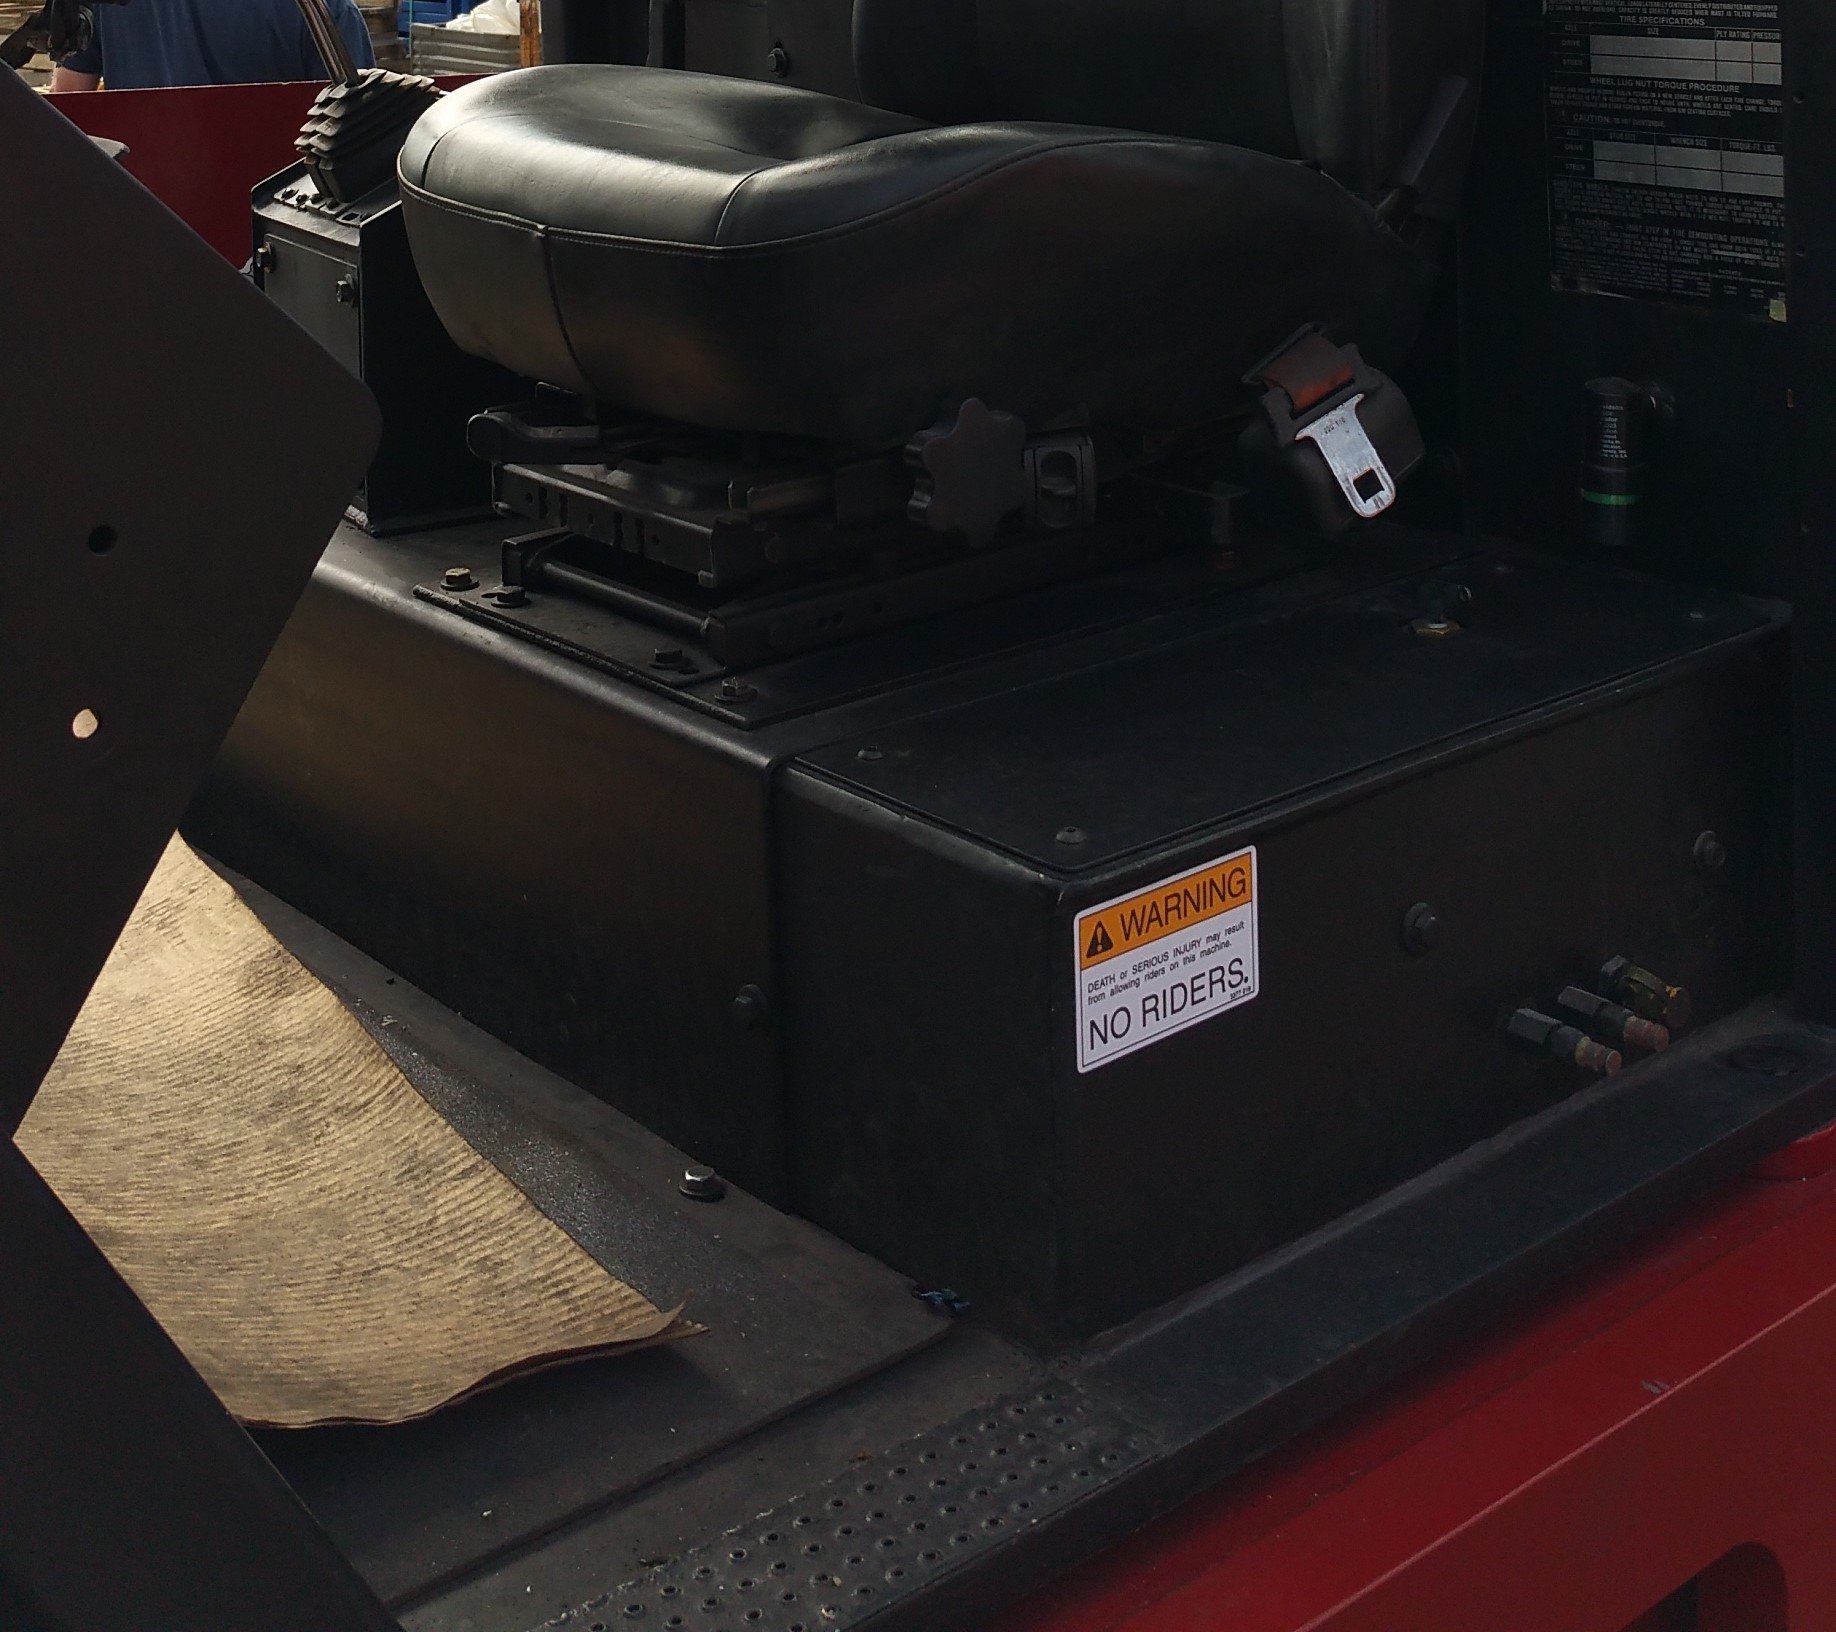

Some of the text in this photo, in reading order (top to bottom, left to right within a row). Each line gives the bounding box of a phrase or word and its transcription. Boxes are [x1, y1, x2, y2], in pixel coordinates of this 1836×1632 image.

[1619, 15, 1705, 26] TIRE SPECIFICATIONS
[1589, 77, 1741, 93] WHEEL LUG NUT TORQUE PROCEDURE
[1119, 866, 1247, 942] WARNING
[1087, 939, 1232, 1006] from allowing riders on this machine.
[1088, 920, 1245, 994] DEATH or SERIOUS INJURY may result
[1089, 957, 1249, 1051] NO RIDERS.
